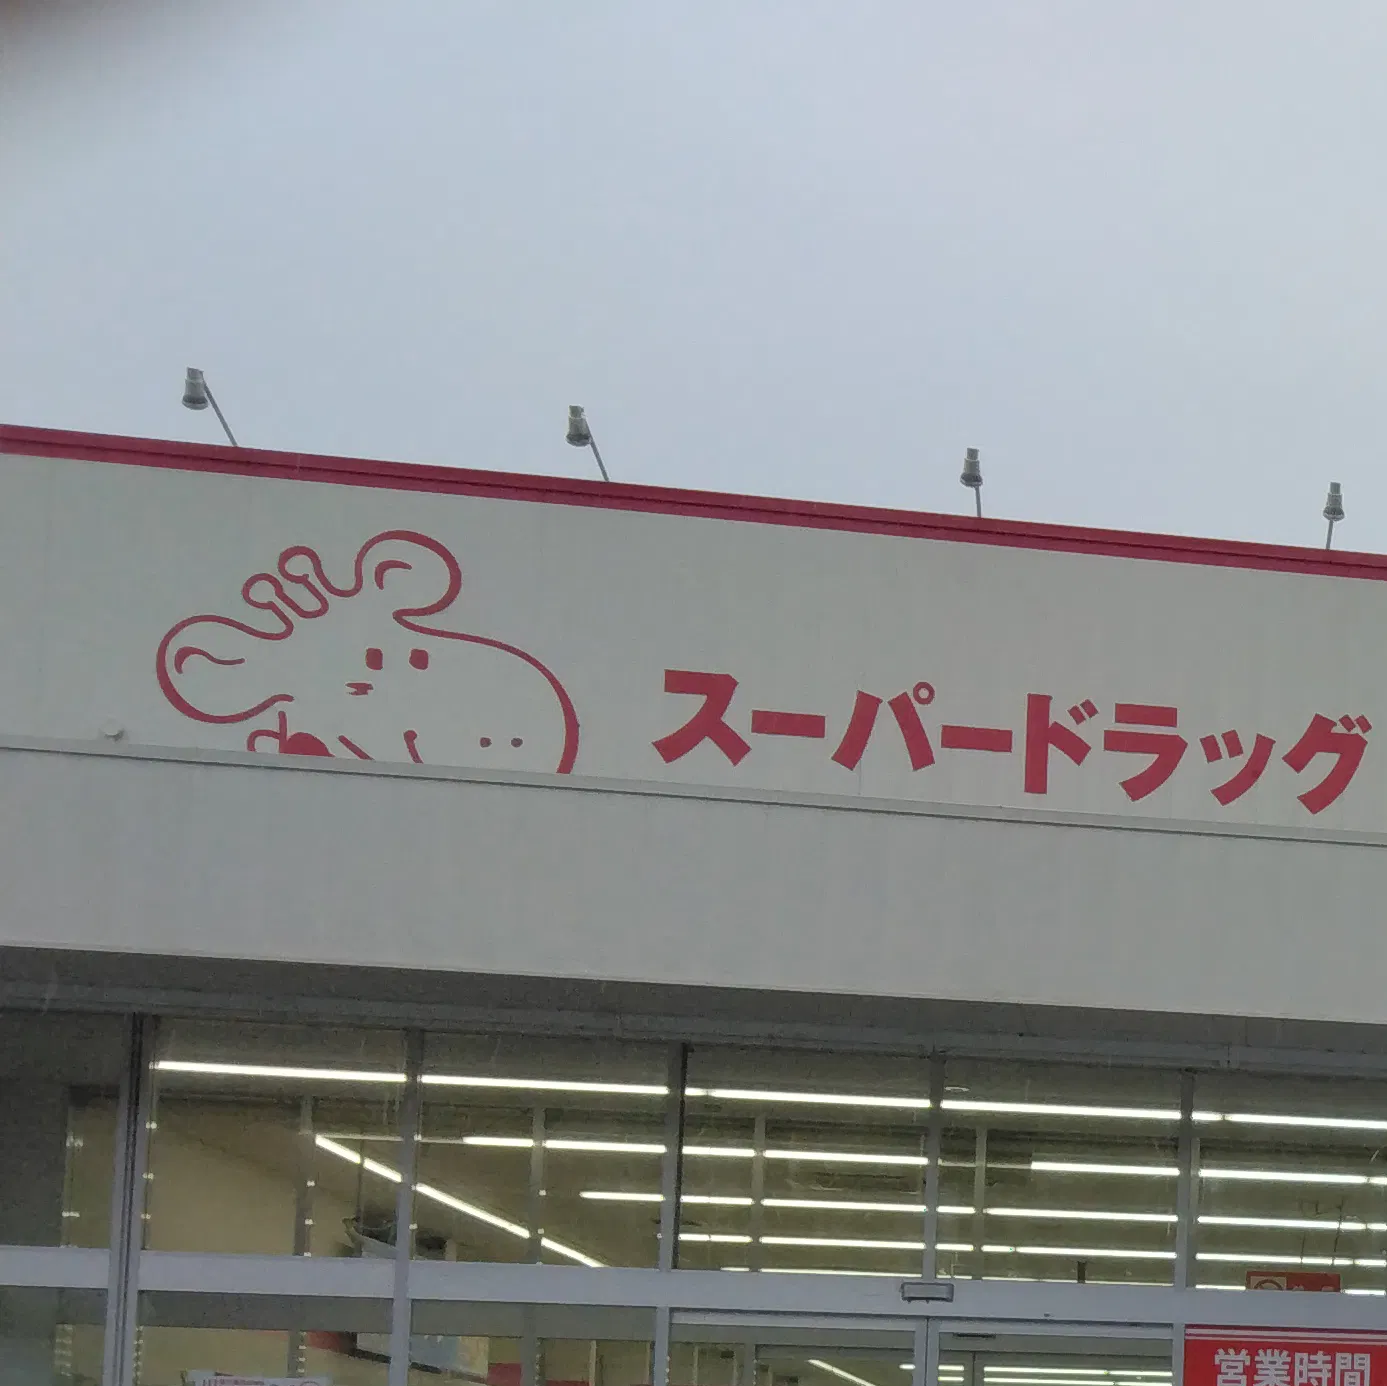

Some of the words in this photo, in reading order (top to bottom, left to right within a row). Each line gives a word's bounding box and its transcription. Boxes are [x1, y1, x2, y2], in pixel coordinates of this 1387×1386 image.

[652, 668, 1372, 815] スーパードラッグ
